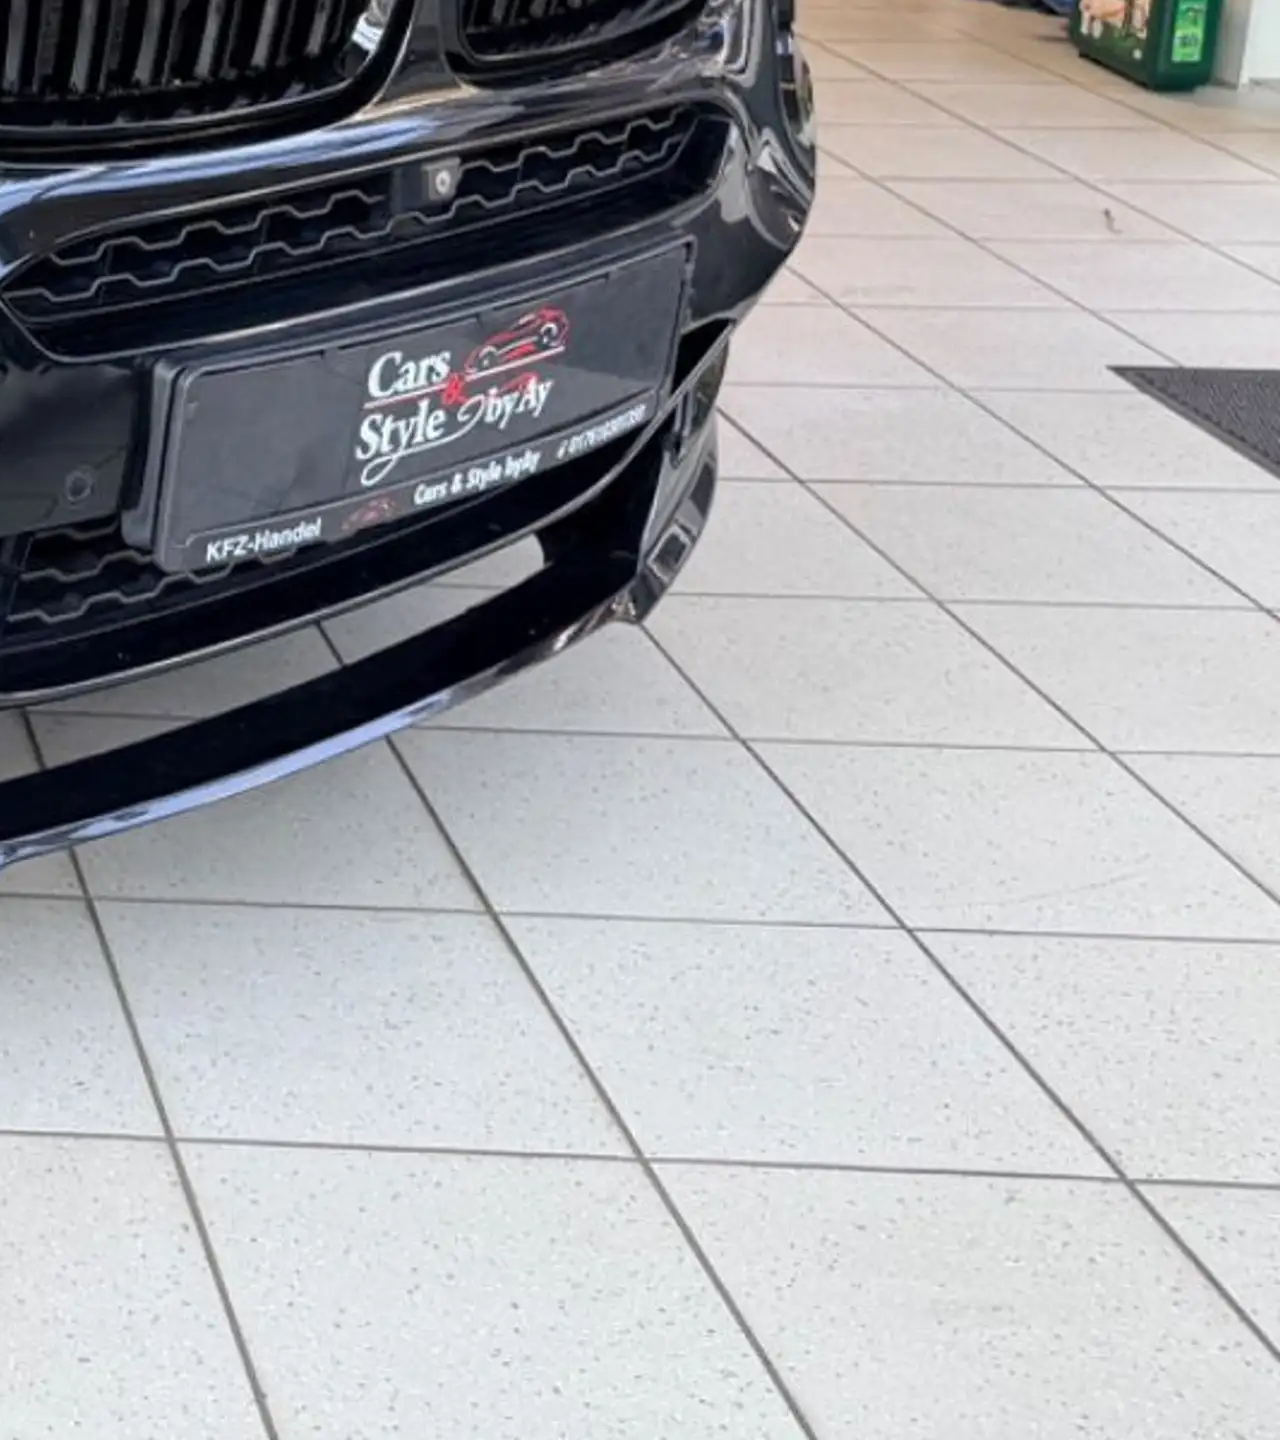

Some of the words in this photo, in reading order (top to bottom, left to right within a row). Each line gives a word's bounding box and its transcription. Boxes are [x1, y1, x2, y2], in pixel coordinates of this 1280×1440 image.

[367, 349, 452, 399] Cars
[442, 372, 468, 405] &
[354, 397, 447, 482] Style
[205, 516, 322, 564] KFZ-Handel
[413, 481, 448, 506] Cars
[465, 459, 503, 491] Style
